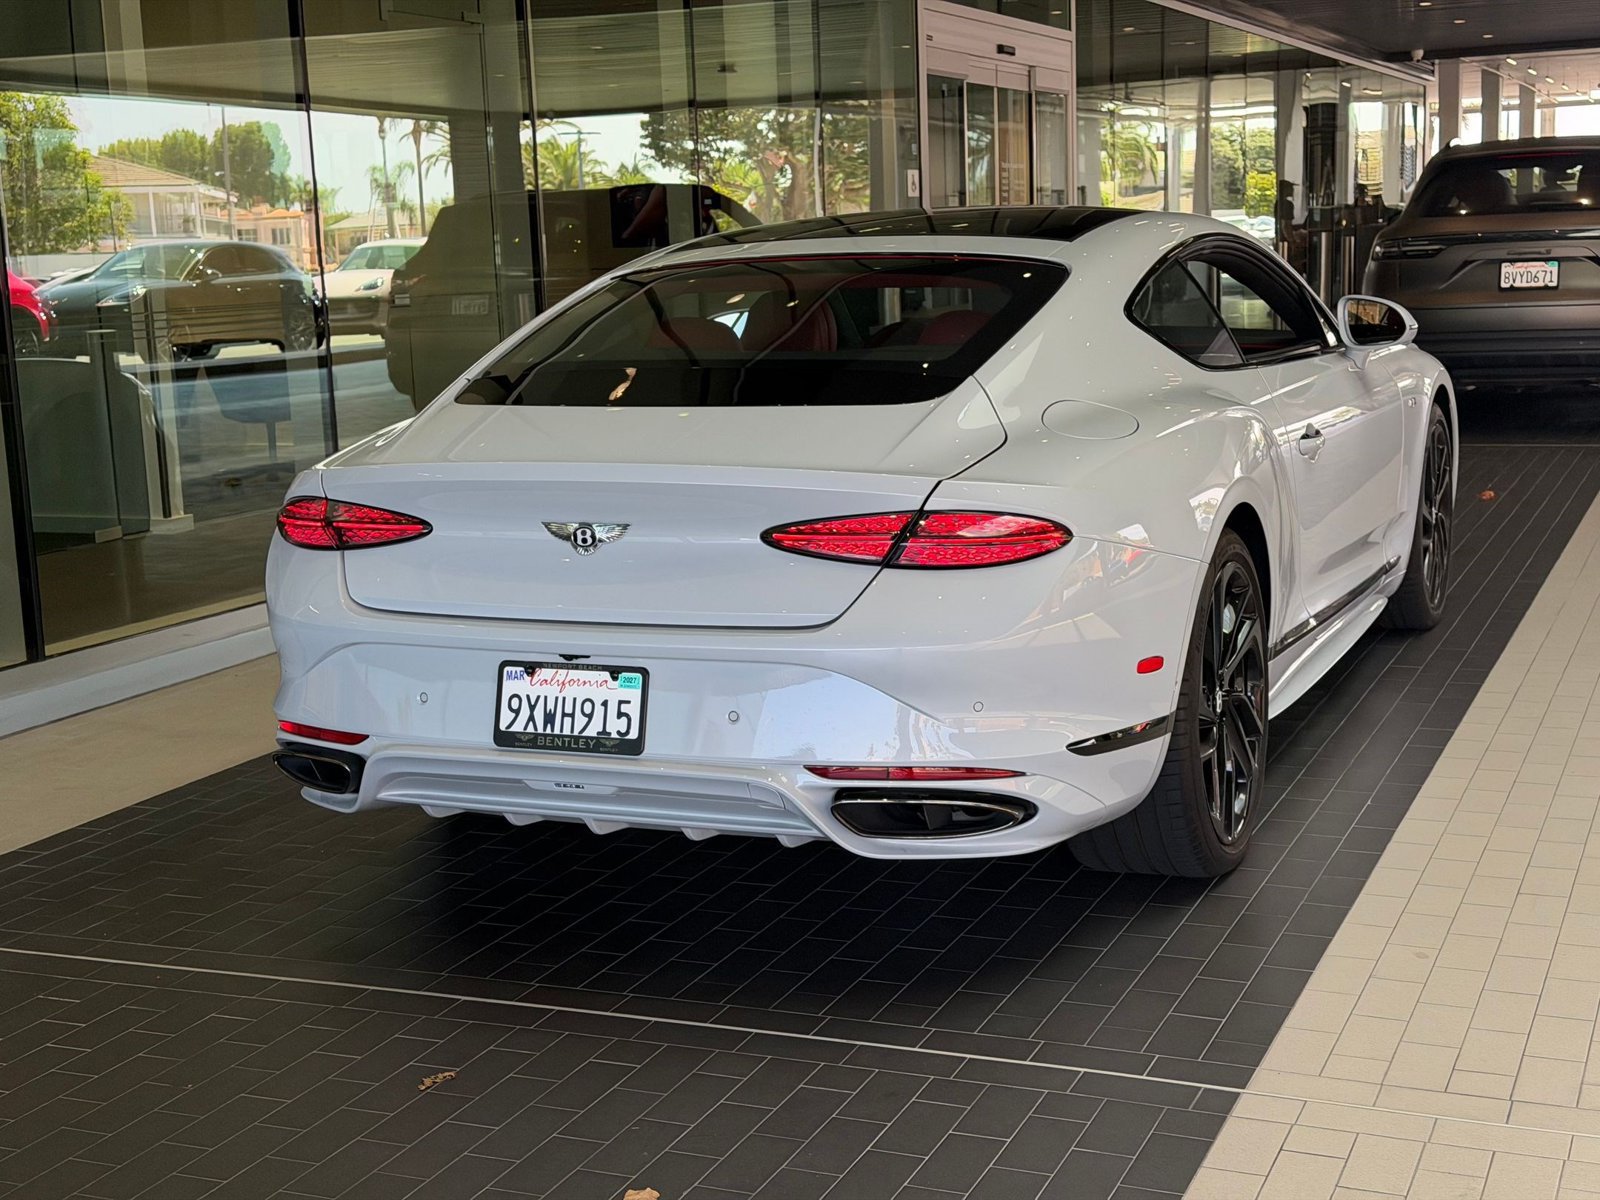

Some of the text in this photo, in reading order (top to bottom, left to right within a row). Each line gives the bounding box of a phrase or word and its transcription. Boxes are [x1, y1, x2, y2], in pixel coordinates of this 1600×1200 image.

[1503, 270, 1554, 284] 8VYD671
[505, 670, 525, 682] MAR
[529, 668, 618, 693] California
[505, 693, 632, 738] 9XWH915
[537, 736, 596, 748] BENTLEY
